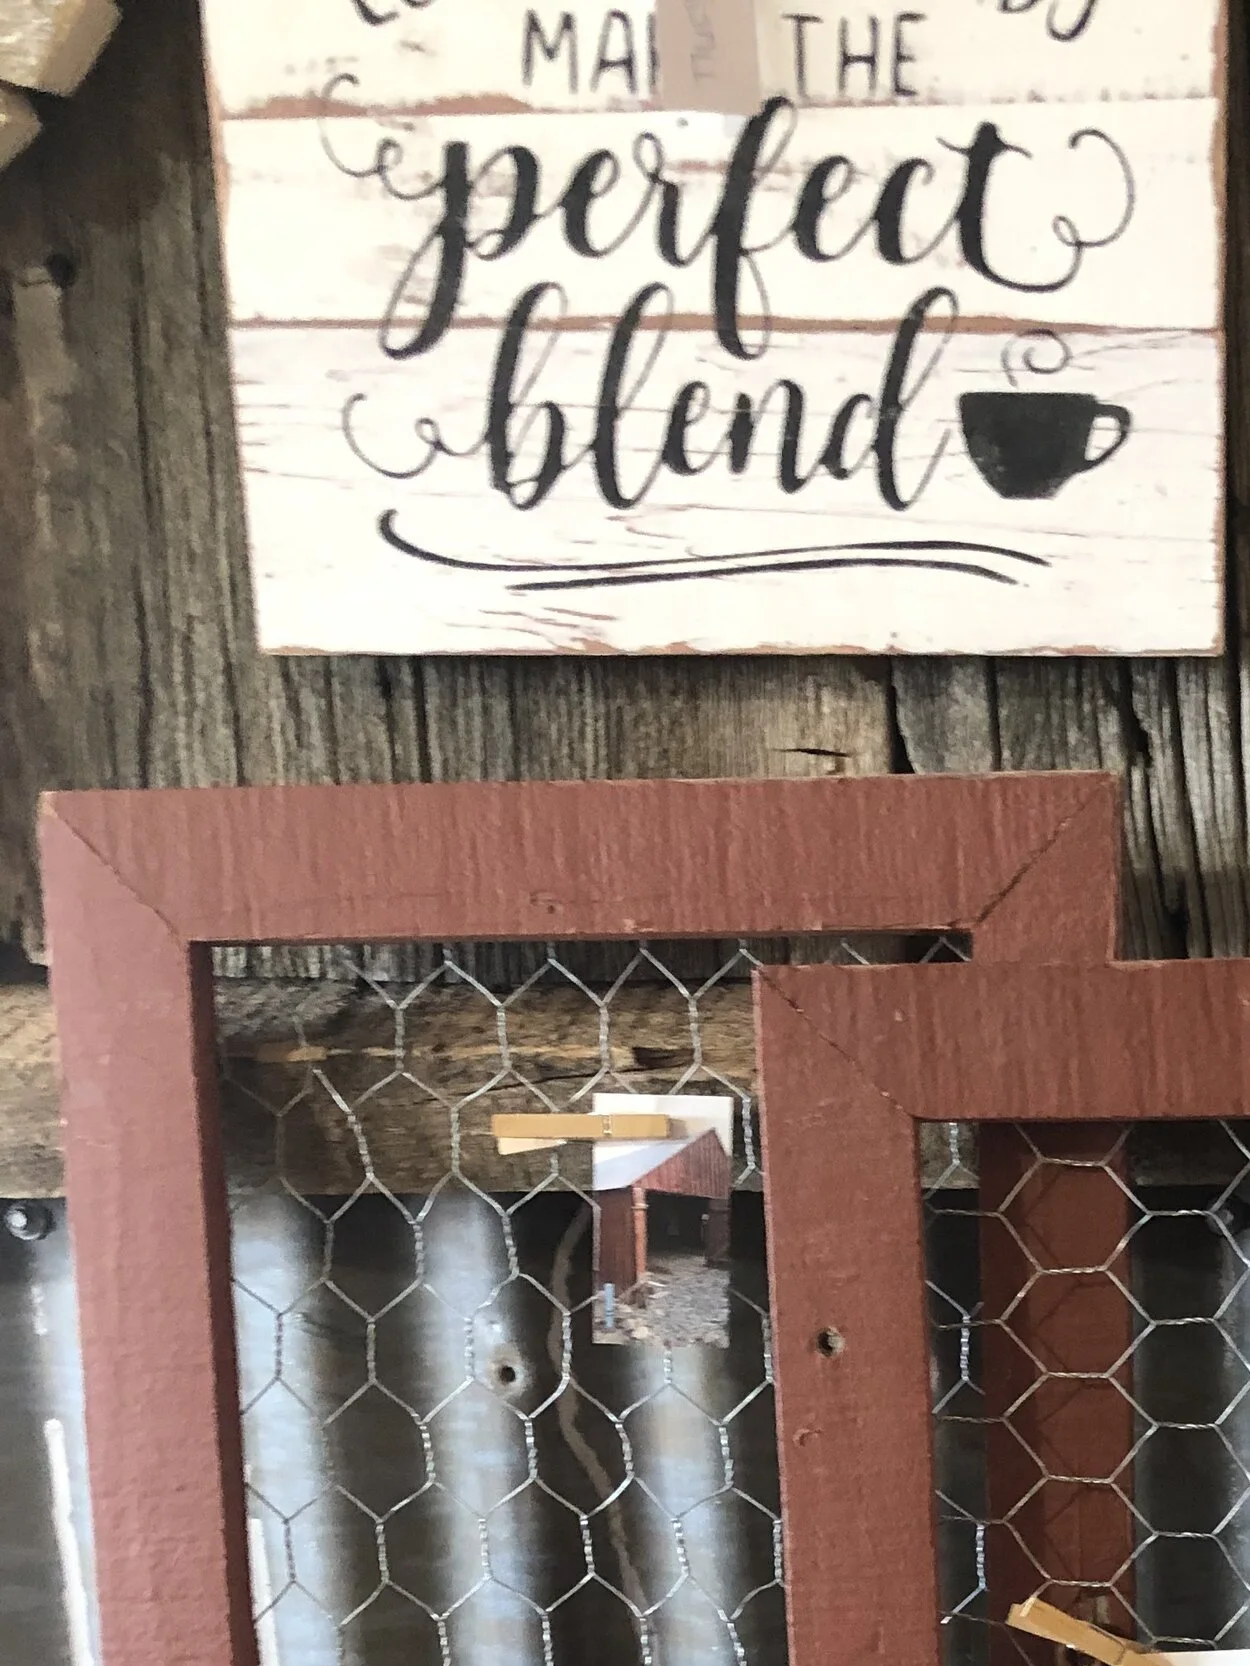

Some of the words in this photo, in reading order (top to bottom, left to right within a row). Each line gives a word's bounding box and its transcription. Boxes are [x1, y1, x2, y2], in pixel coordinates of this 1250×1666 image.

[781, 11, 927, 99] THE
[321, 76, 1137, 361] perfect
[341, 281, 962, 512] blend
